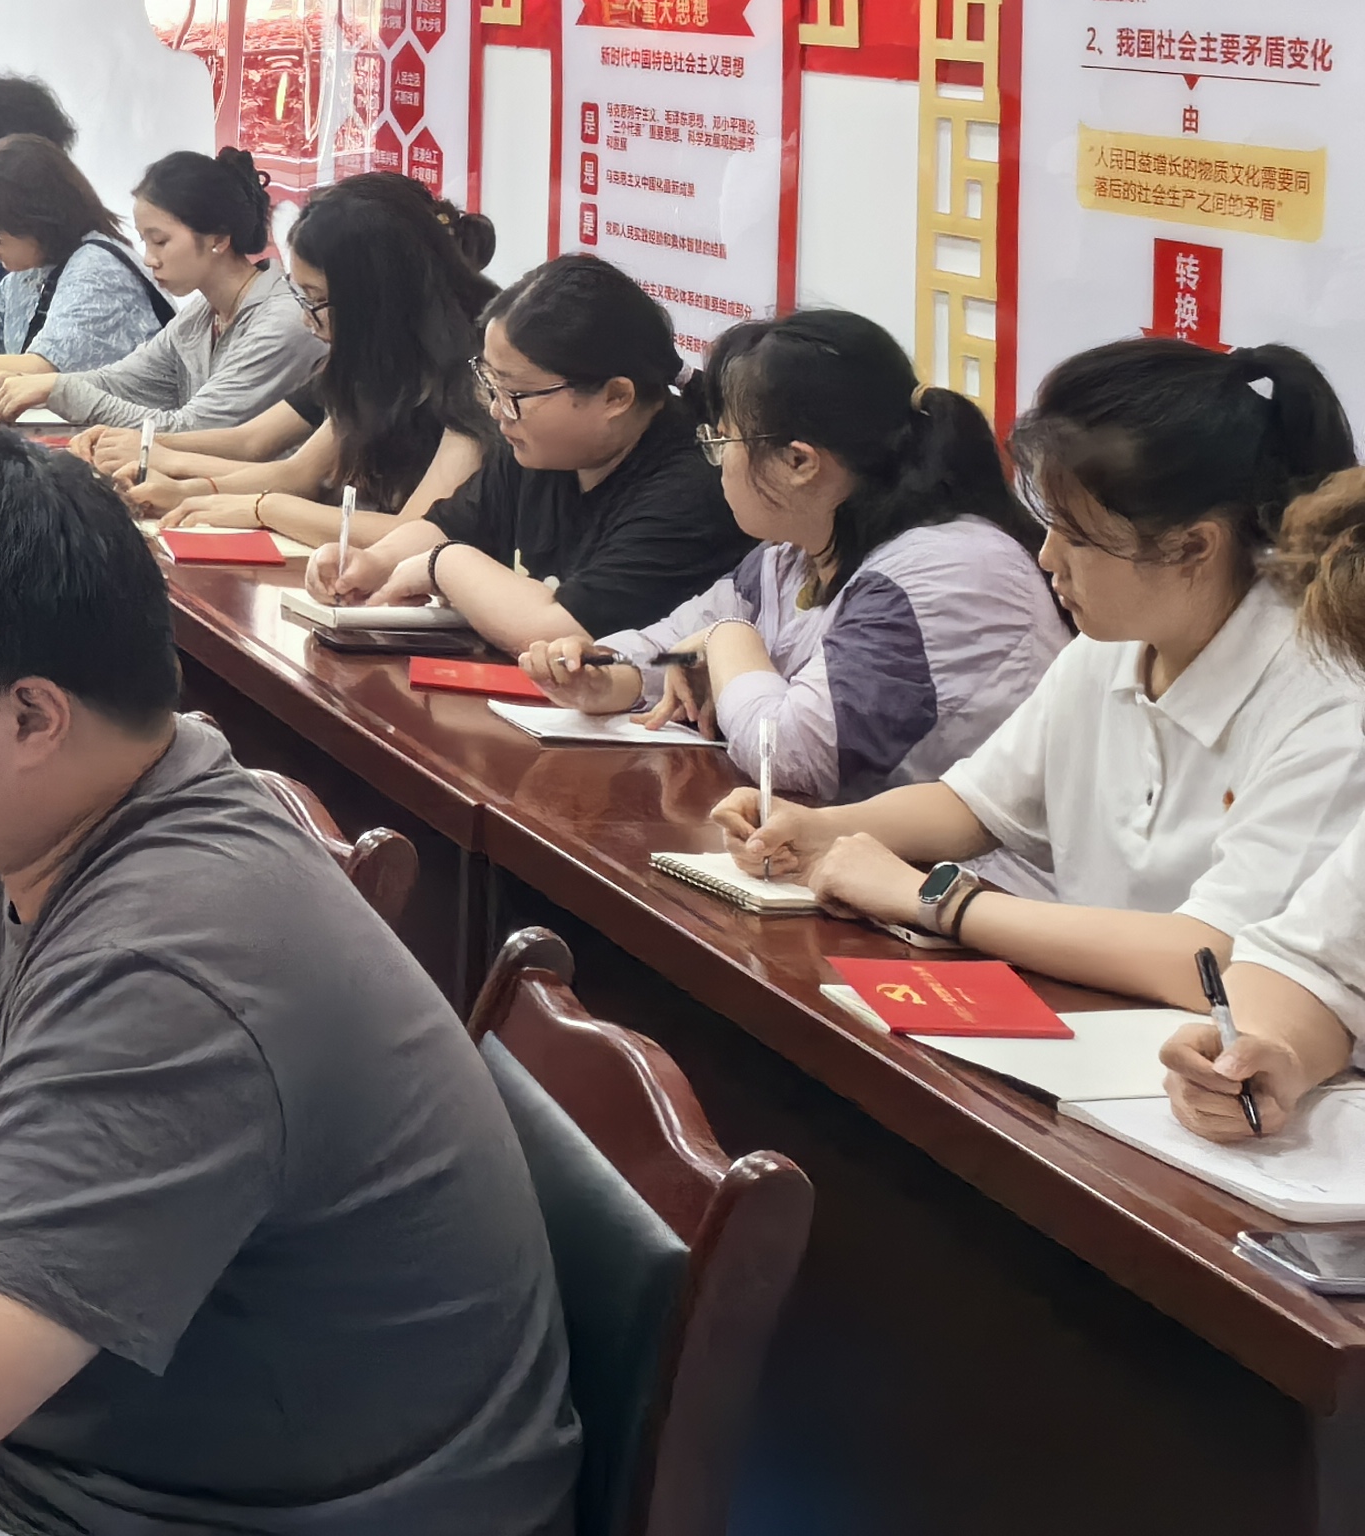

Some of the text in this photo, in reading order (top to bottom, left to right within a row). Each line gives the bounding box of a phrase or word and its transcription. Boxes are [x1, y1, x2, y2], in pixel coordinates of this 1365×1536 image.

[601, 46, 744, 78] 新时代中国特色社会主义思想
[1086, 27, 1333, 72] 2、我国社会主要矛盾变化
[584, 111, 595, 134] 是
[1182, 105, 1199, 133] 由
[584, 161, 594, 185] 是
[583, 211, 594, 236] 是
